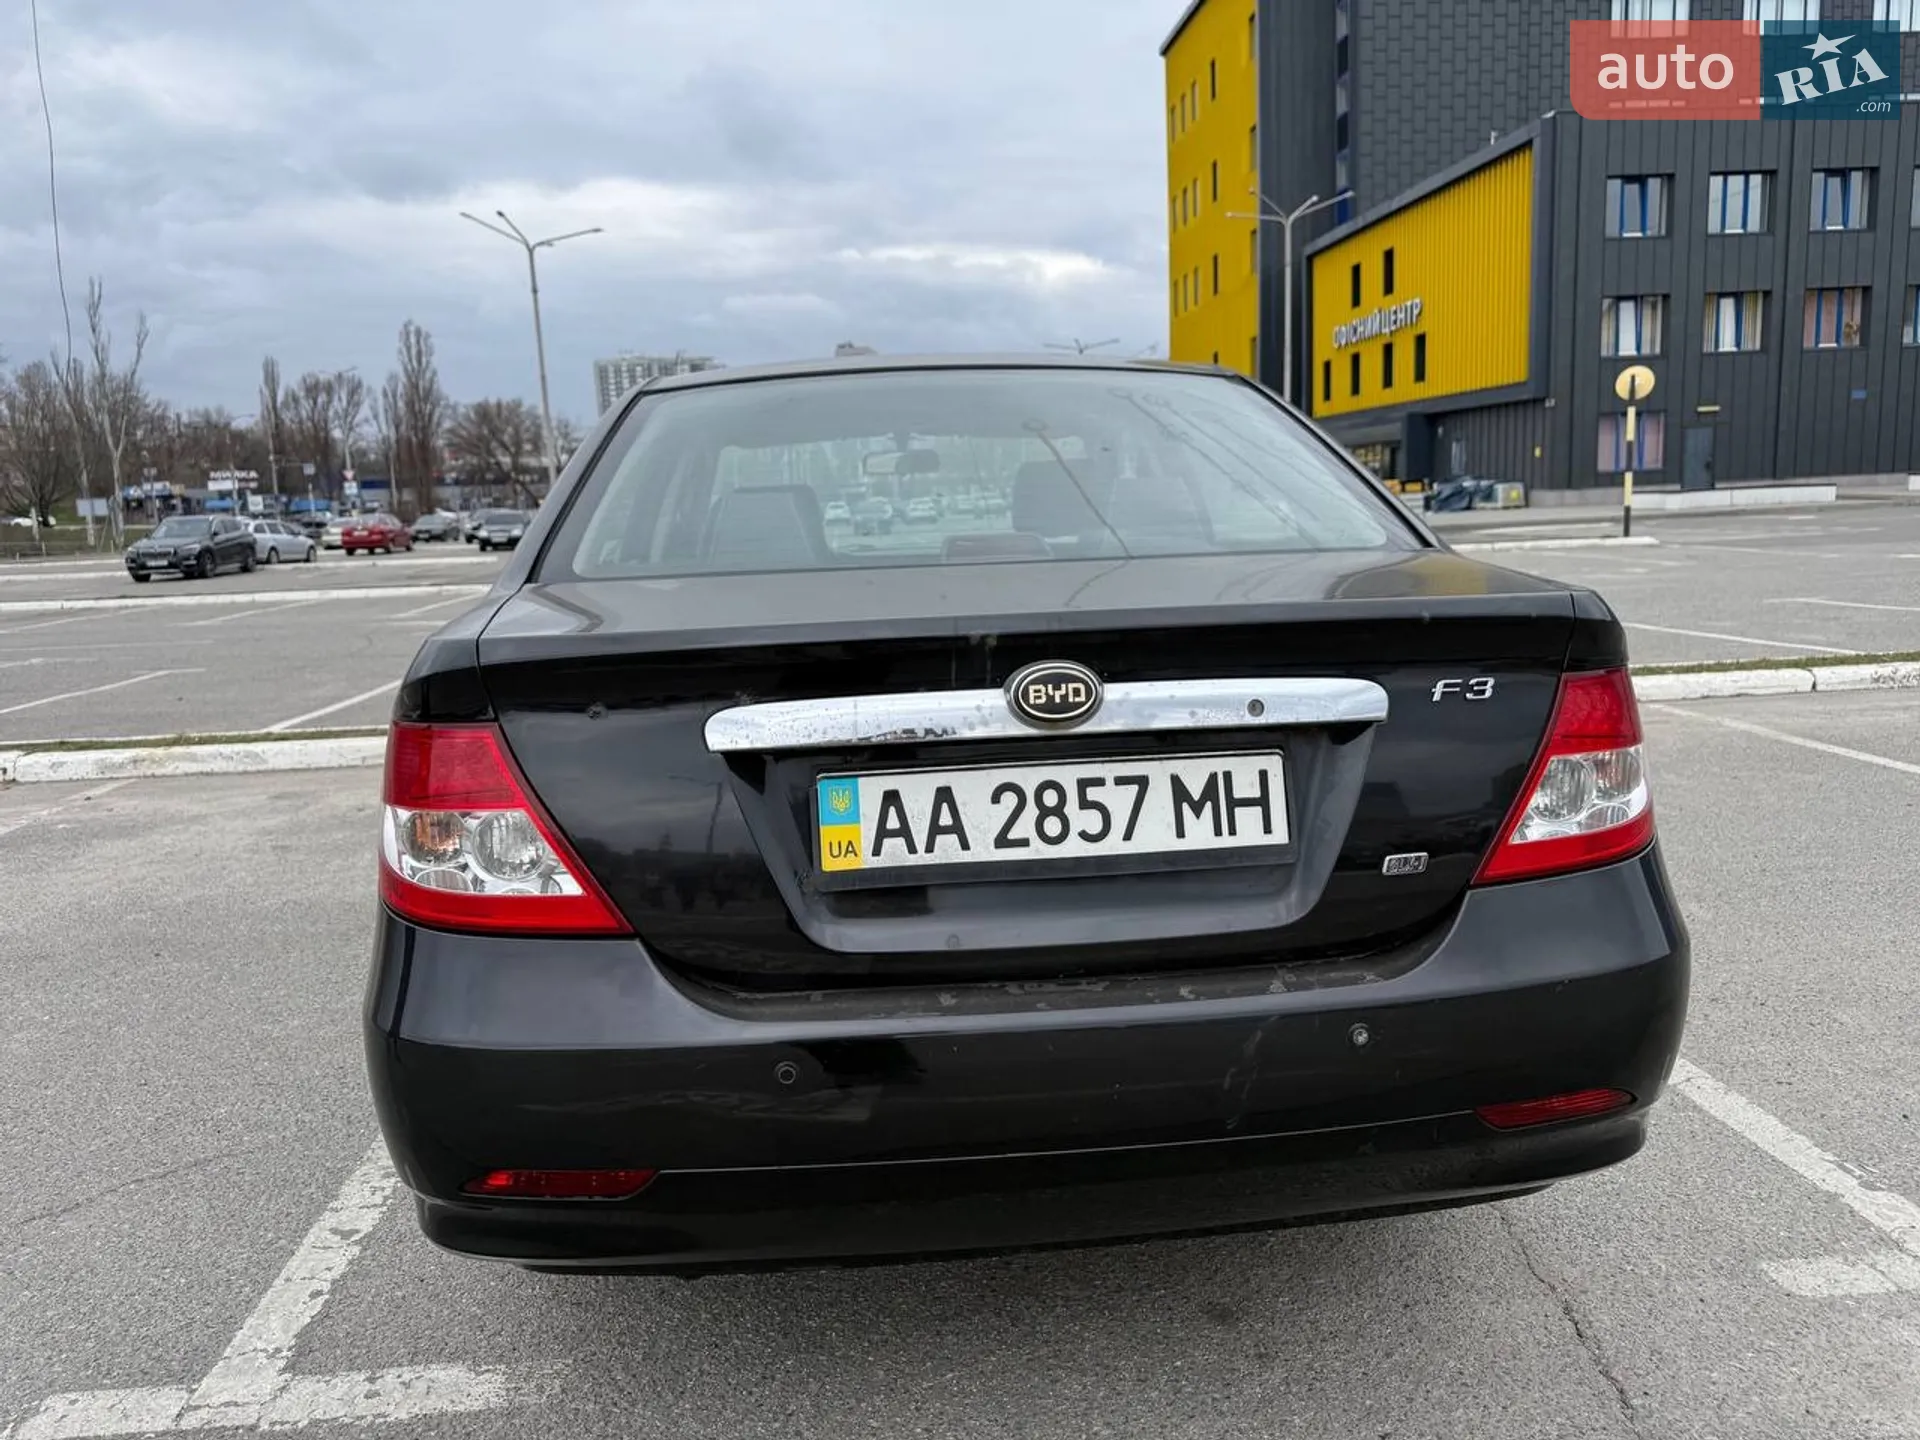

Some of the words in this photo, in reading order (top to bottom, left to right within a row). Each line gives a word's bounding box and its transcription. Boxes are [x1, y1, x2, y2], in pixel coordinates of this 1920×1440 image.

[1028, 682, 1086, 705] BYD
[1431, 676, 1495, 701] F3
[871, 785, 971, 857] AA
[990, 774, 1150, 849] 2857
[1169, 769, 1274, 839] MH
[829, 840, 858, 858] UA
